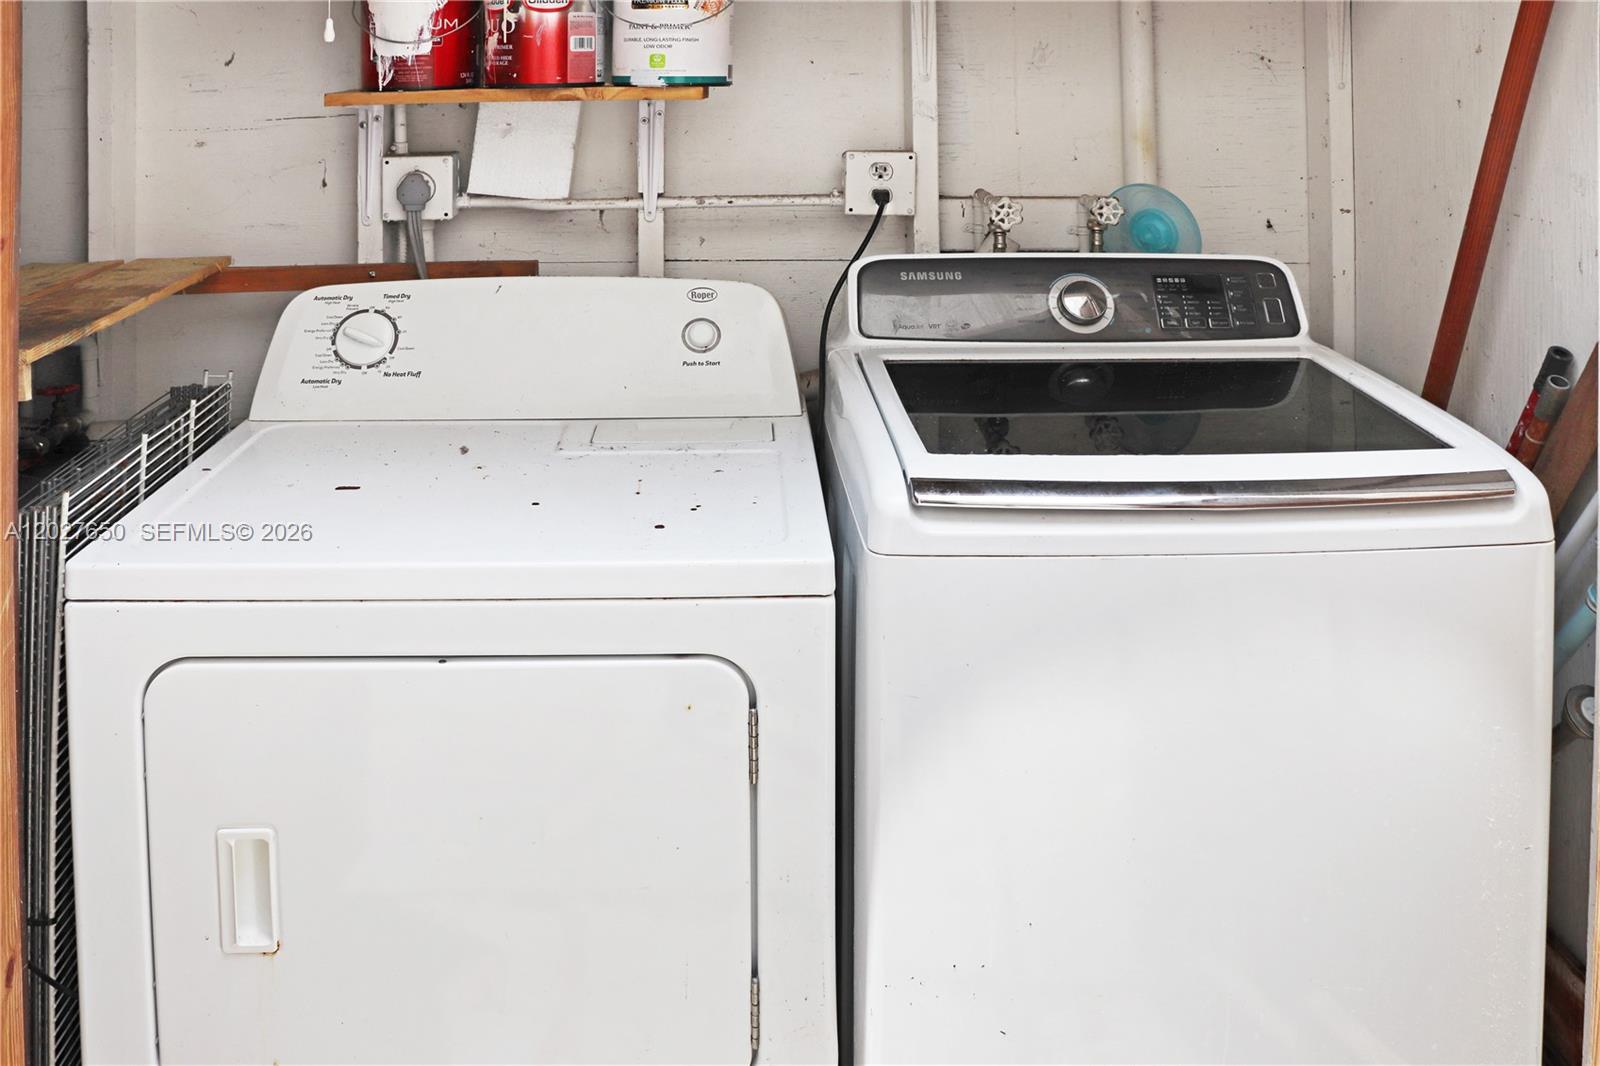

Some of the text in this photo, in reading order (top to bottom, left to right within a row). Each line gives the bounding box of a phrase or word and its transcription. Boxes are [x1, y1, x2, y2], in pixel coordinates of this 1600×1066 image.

[900, 271, 963, 280] SAMSUNG
[342, 294, 354, 302] Dry
[690, 291, 715, 300] Roper
[406, 370, 422, 378] Fluff
[331, 378, 342, 386] Dry
